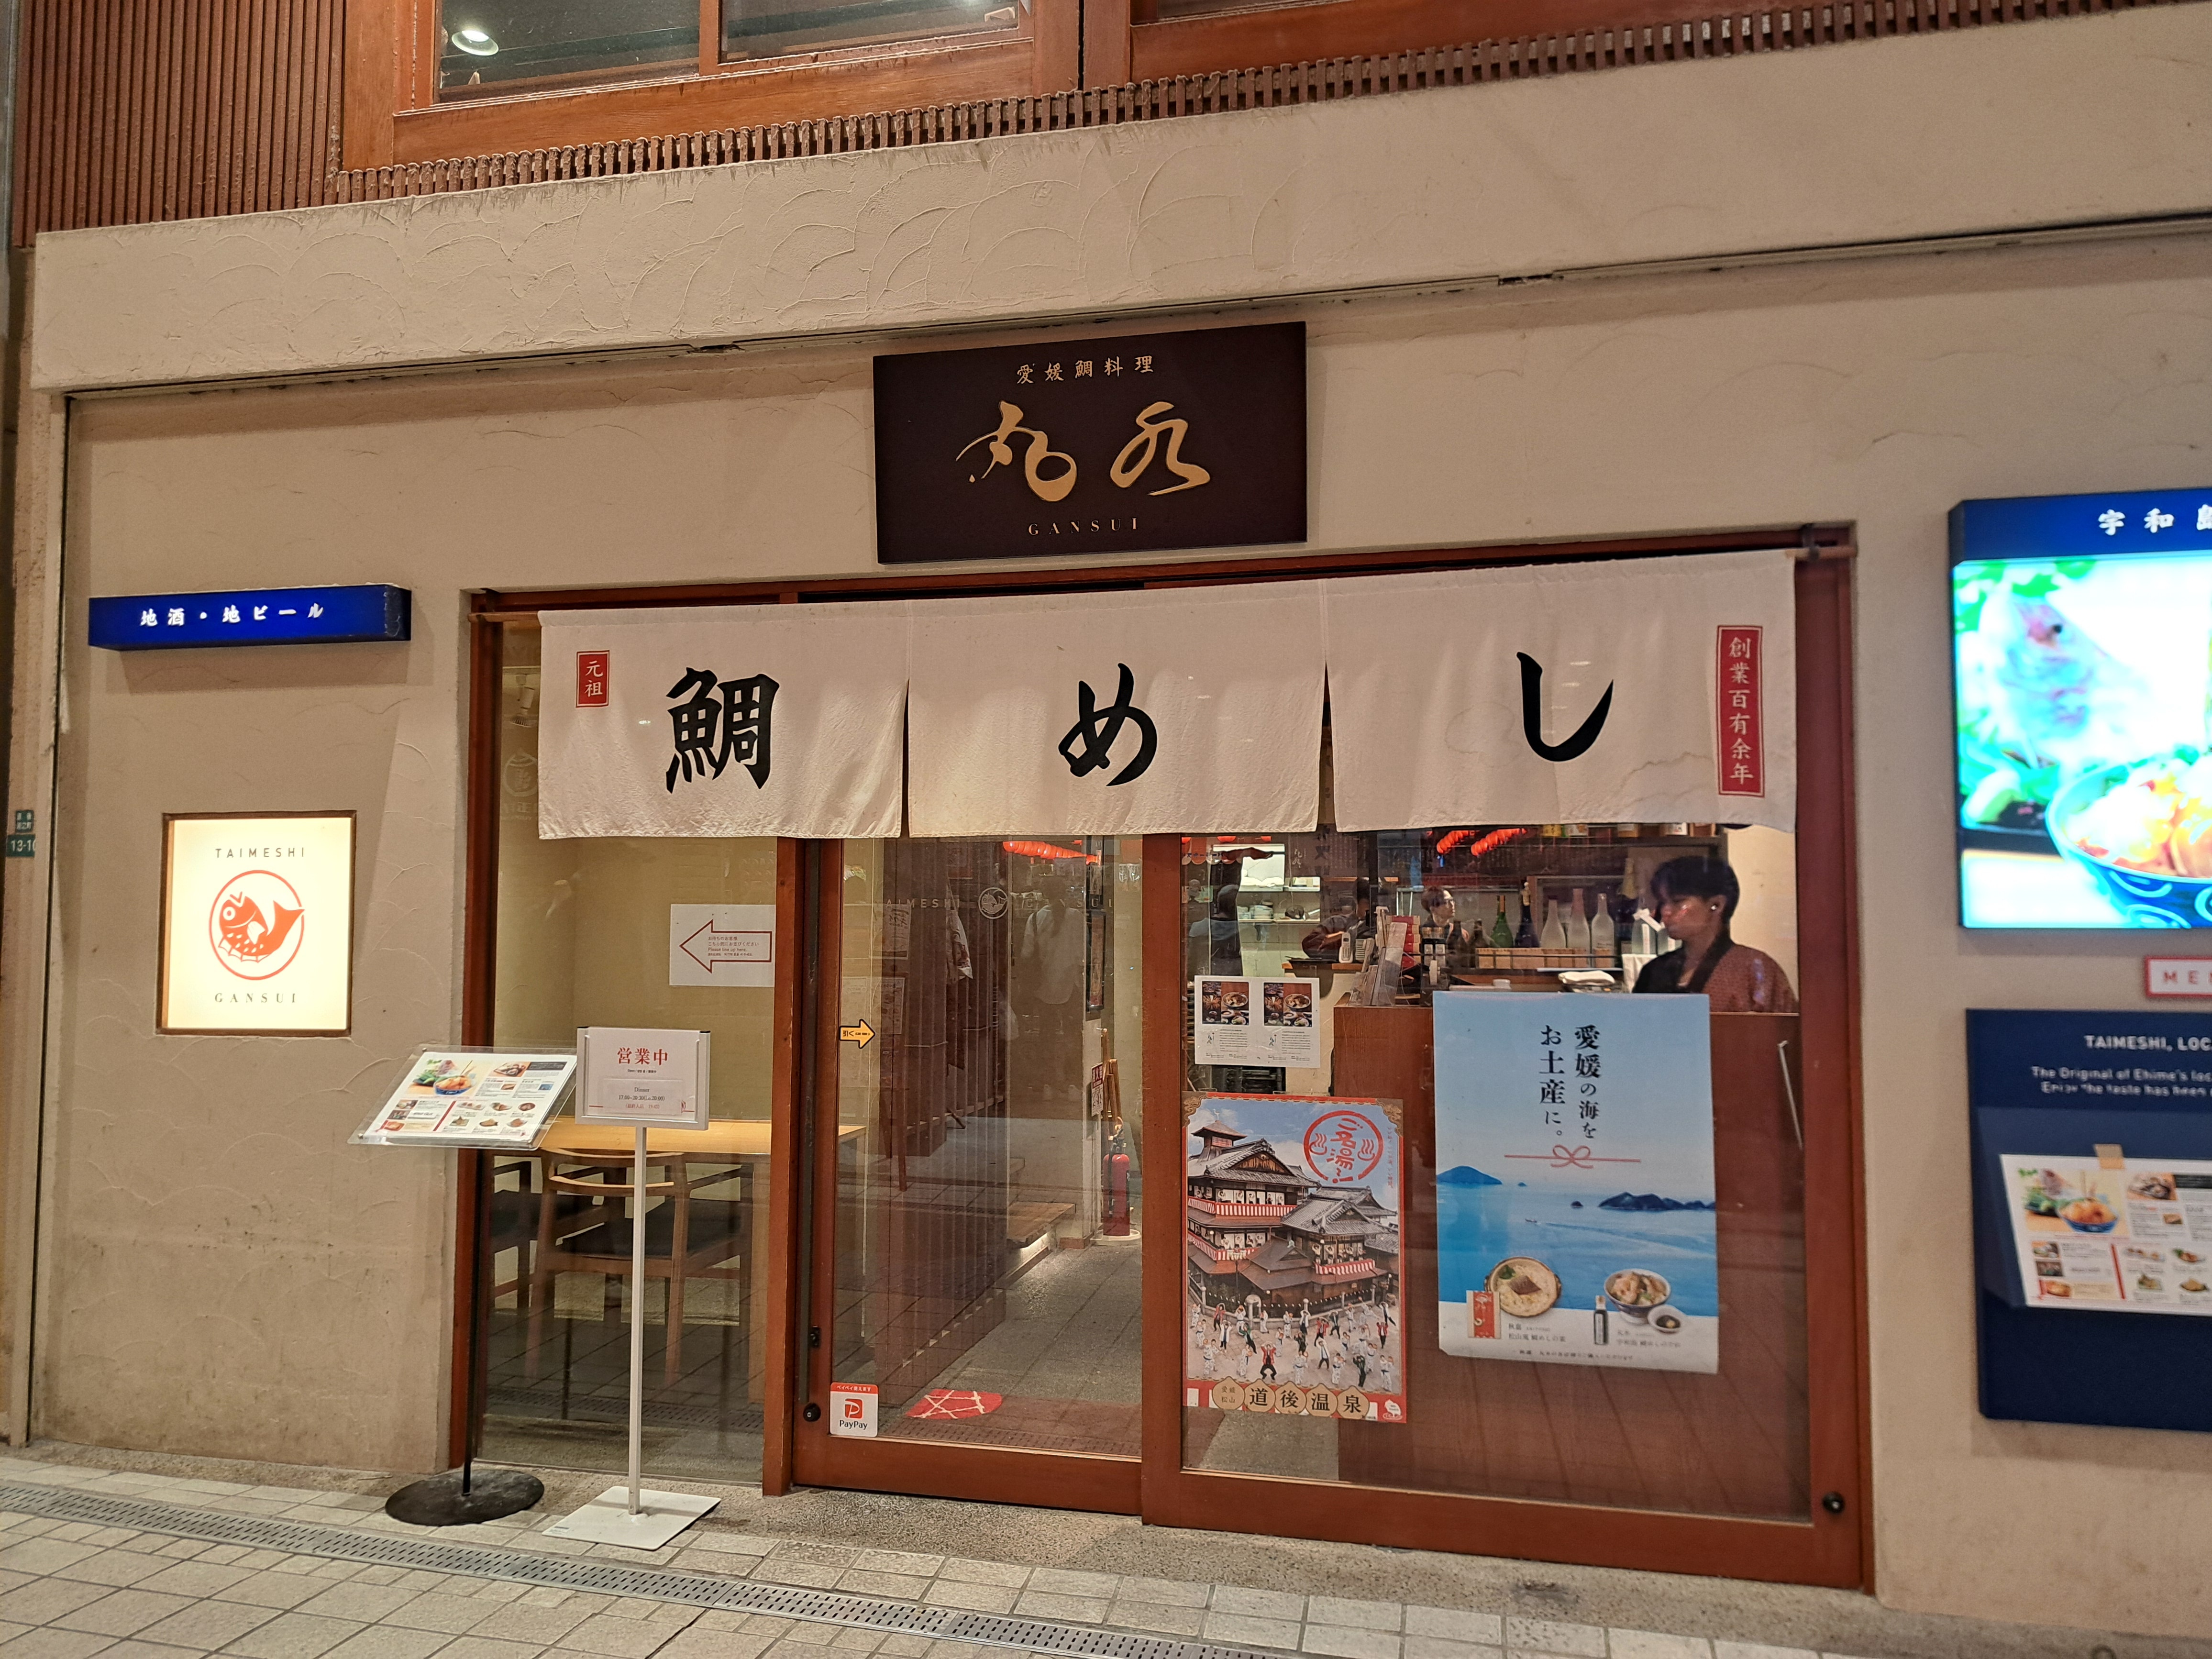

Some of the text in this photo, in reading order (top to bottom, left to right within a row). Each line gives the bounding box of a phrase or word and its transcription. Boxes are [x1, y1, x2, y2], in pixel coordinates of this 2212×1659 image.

[1016, 355, 1154, 384] 愛媛鯛料理
[1028, 517, 1139, 536] GANSUI
[140, 603, 323, 627] 地酒・地ビール
[584, 660, 604, 697] 元祖
[1728, 636, 1754, 785] 創業百有余年
[215, 847, 304, 859] TAIMESHI
[885, 898, 960, 908] AIMESHI
[215, 993, 296, 1003] GANSUI
[2177, 1037, 2212, 1051] LOC
[617, 1047, 668, 1066] 営業中
[1539, 1025, 1565, 1137] お土産に。
[1574, 1024, 1601, 1139] 愛媛の海を
[2032, 1066, 2057, 1078] The
[2116, 1069, 2131, 1080] of
[1249, 1387, 1362, 1413] 道後温泉
[840, 1420, 867, 1430] PayPay
